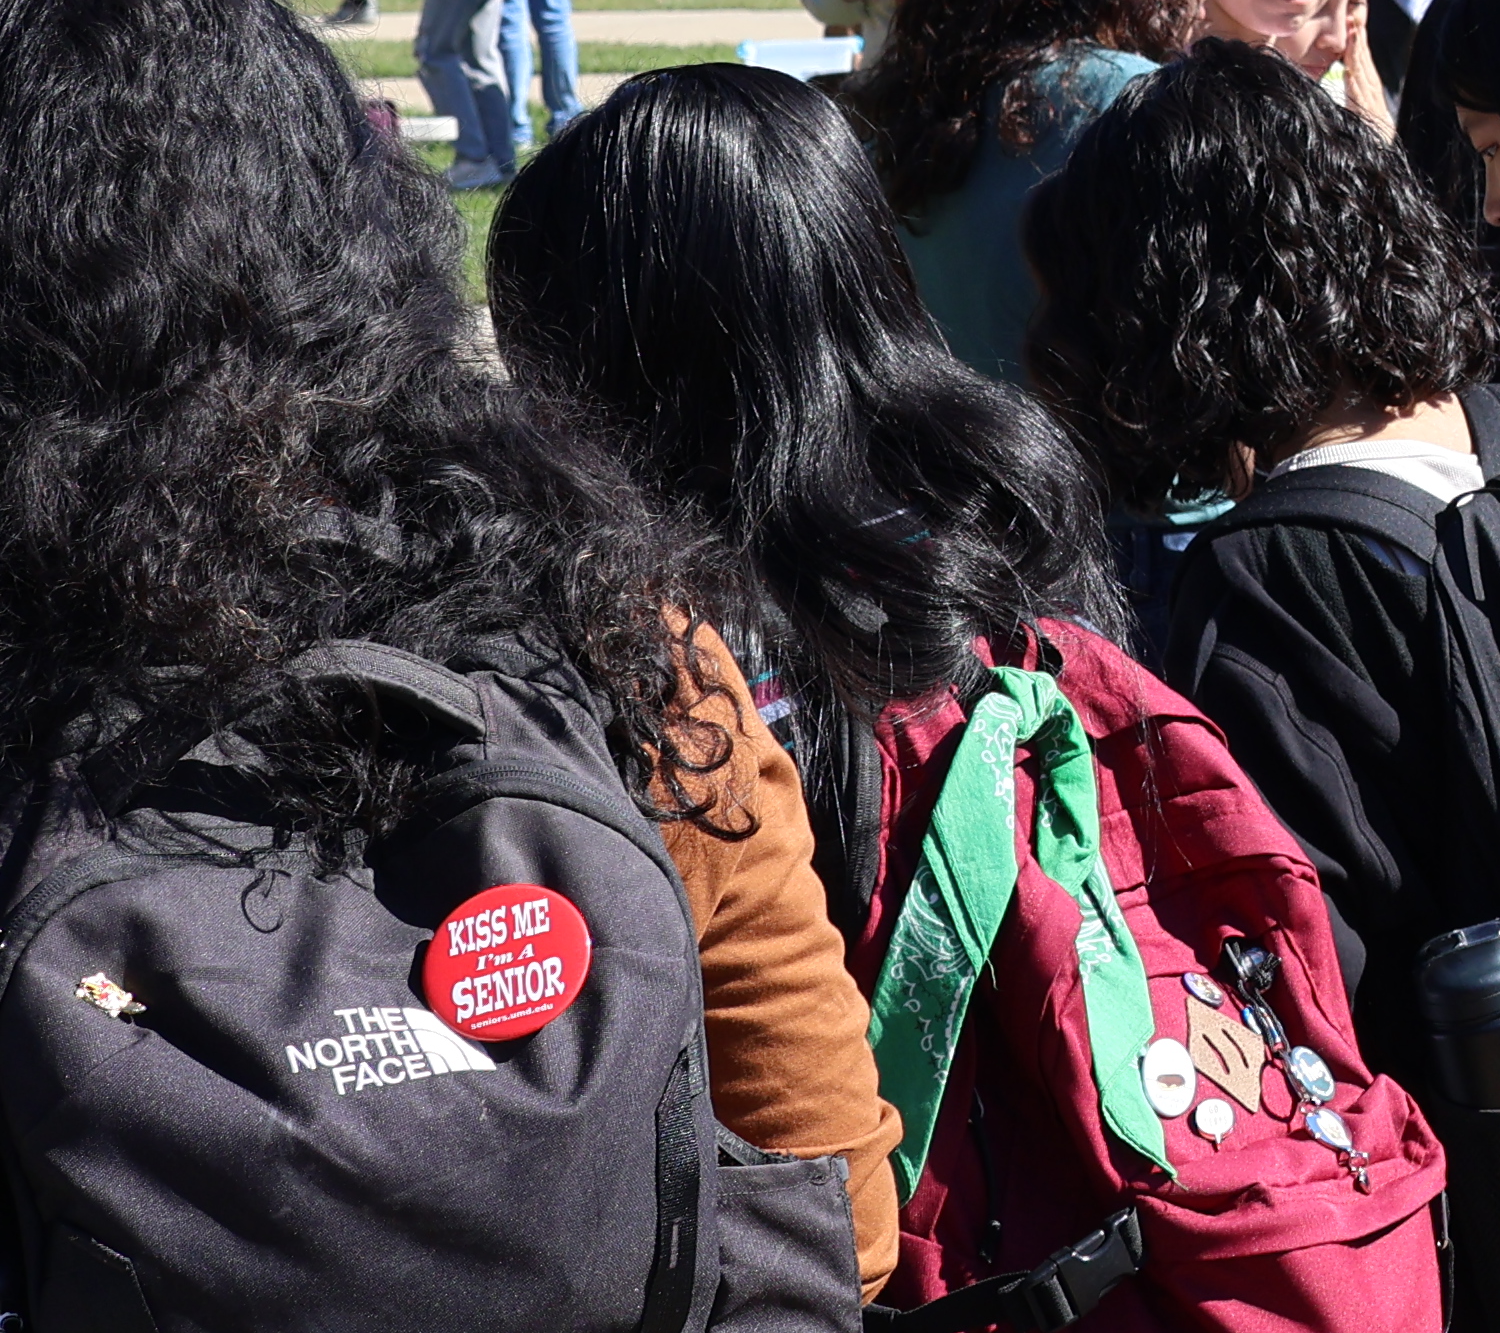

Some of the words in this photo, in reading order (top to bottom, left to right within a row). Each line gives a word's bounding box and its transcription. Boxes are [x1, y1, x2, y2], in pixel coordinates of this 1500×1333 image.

[447, 905, 508, 957] KISS
[511, 897, 550, 940] ME
[475, 951, 514, 971] I'm
[517, 942, 535, 960] A
[452, 956, 566, 1024] SENIOR
[333, 1006, 409, 1034] THE
[470, 1002, 554, 1030] seniors.umd.edu
[285, 1030, 421, 1074] NORTH
[332, 1053, 432, 1096] FACE
